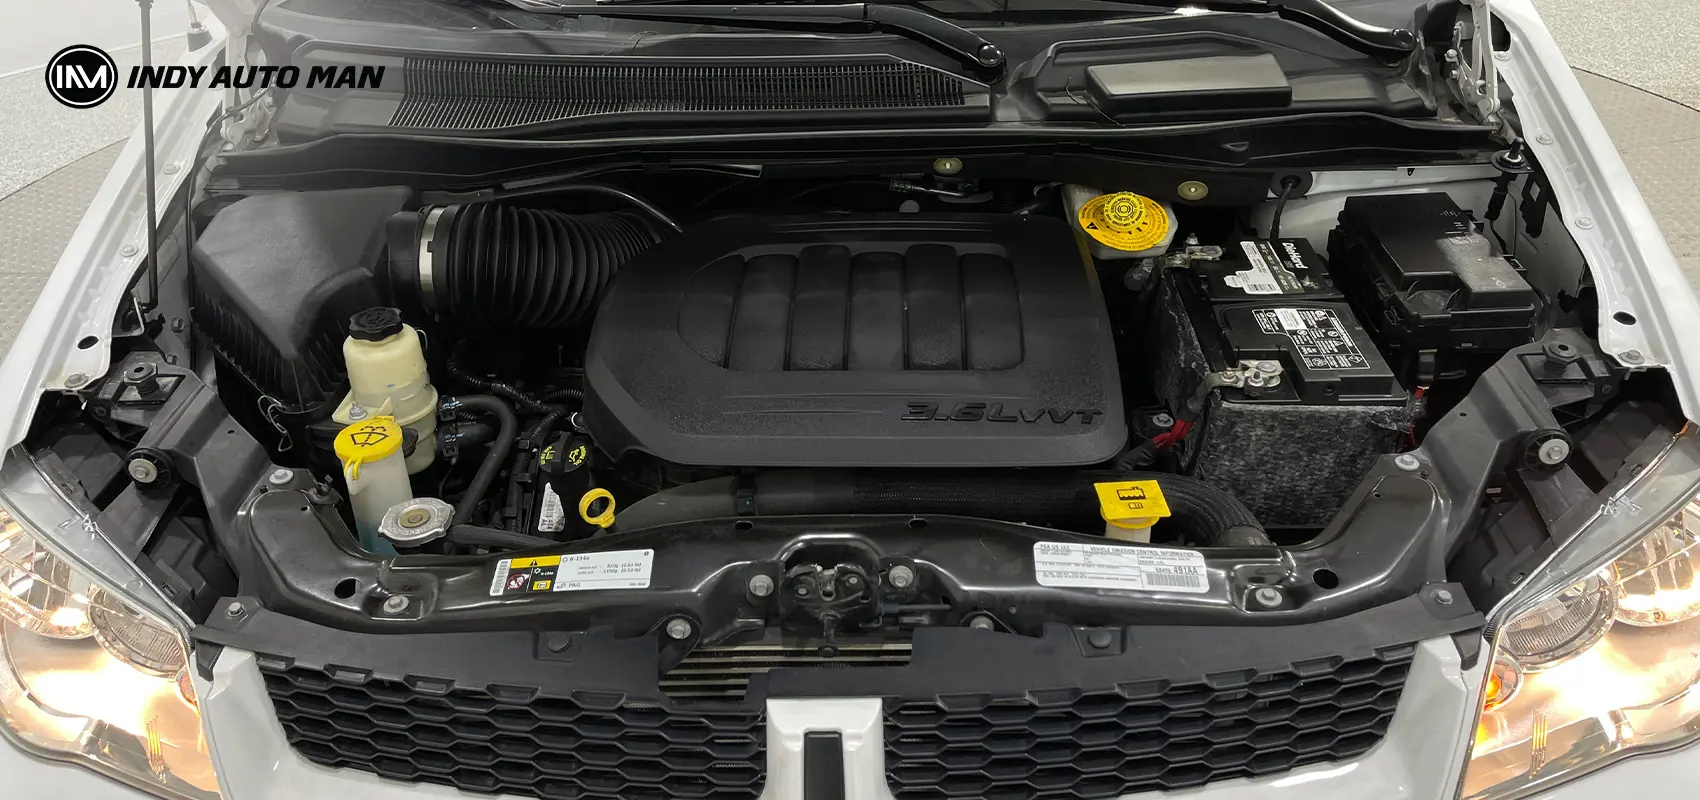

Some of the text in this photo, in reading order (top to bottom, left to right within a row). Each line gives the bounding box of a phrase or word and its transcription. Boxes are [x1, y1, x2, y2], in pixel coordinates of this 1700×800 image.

[1281, 242, 1309, 269] DieHard
[1111, 547, 1136, 555] EMISSION
[1173, 566, 1199, 575] 491AA
